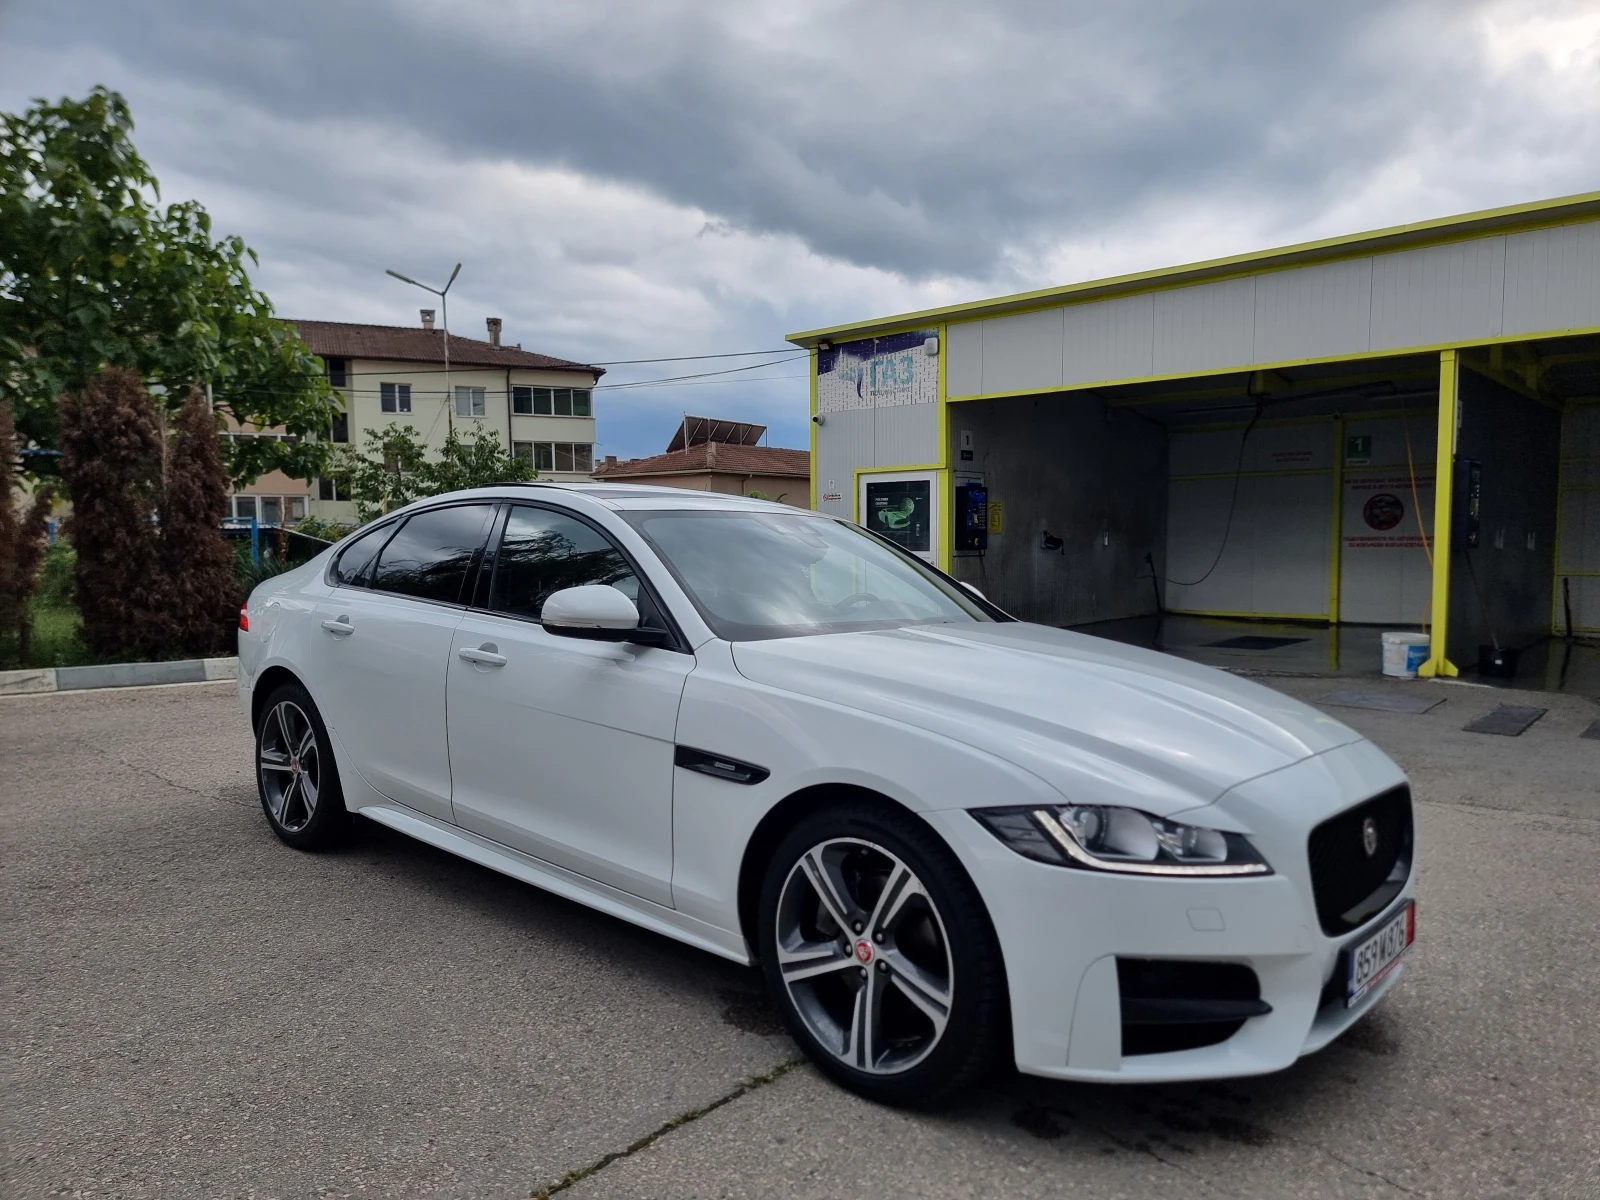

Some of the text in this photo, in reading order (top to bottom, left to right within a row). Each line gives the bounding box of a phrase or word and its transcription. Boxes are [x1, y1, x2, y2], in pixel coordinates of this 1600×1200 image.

[870, 356, 914, 388] ГАЗ
[965, 434, 970, 446] 1
[1355, 437, 1363, 452] 1
